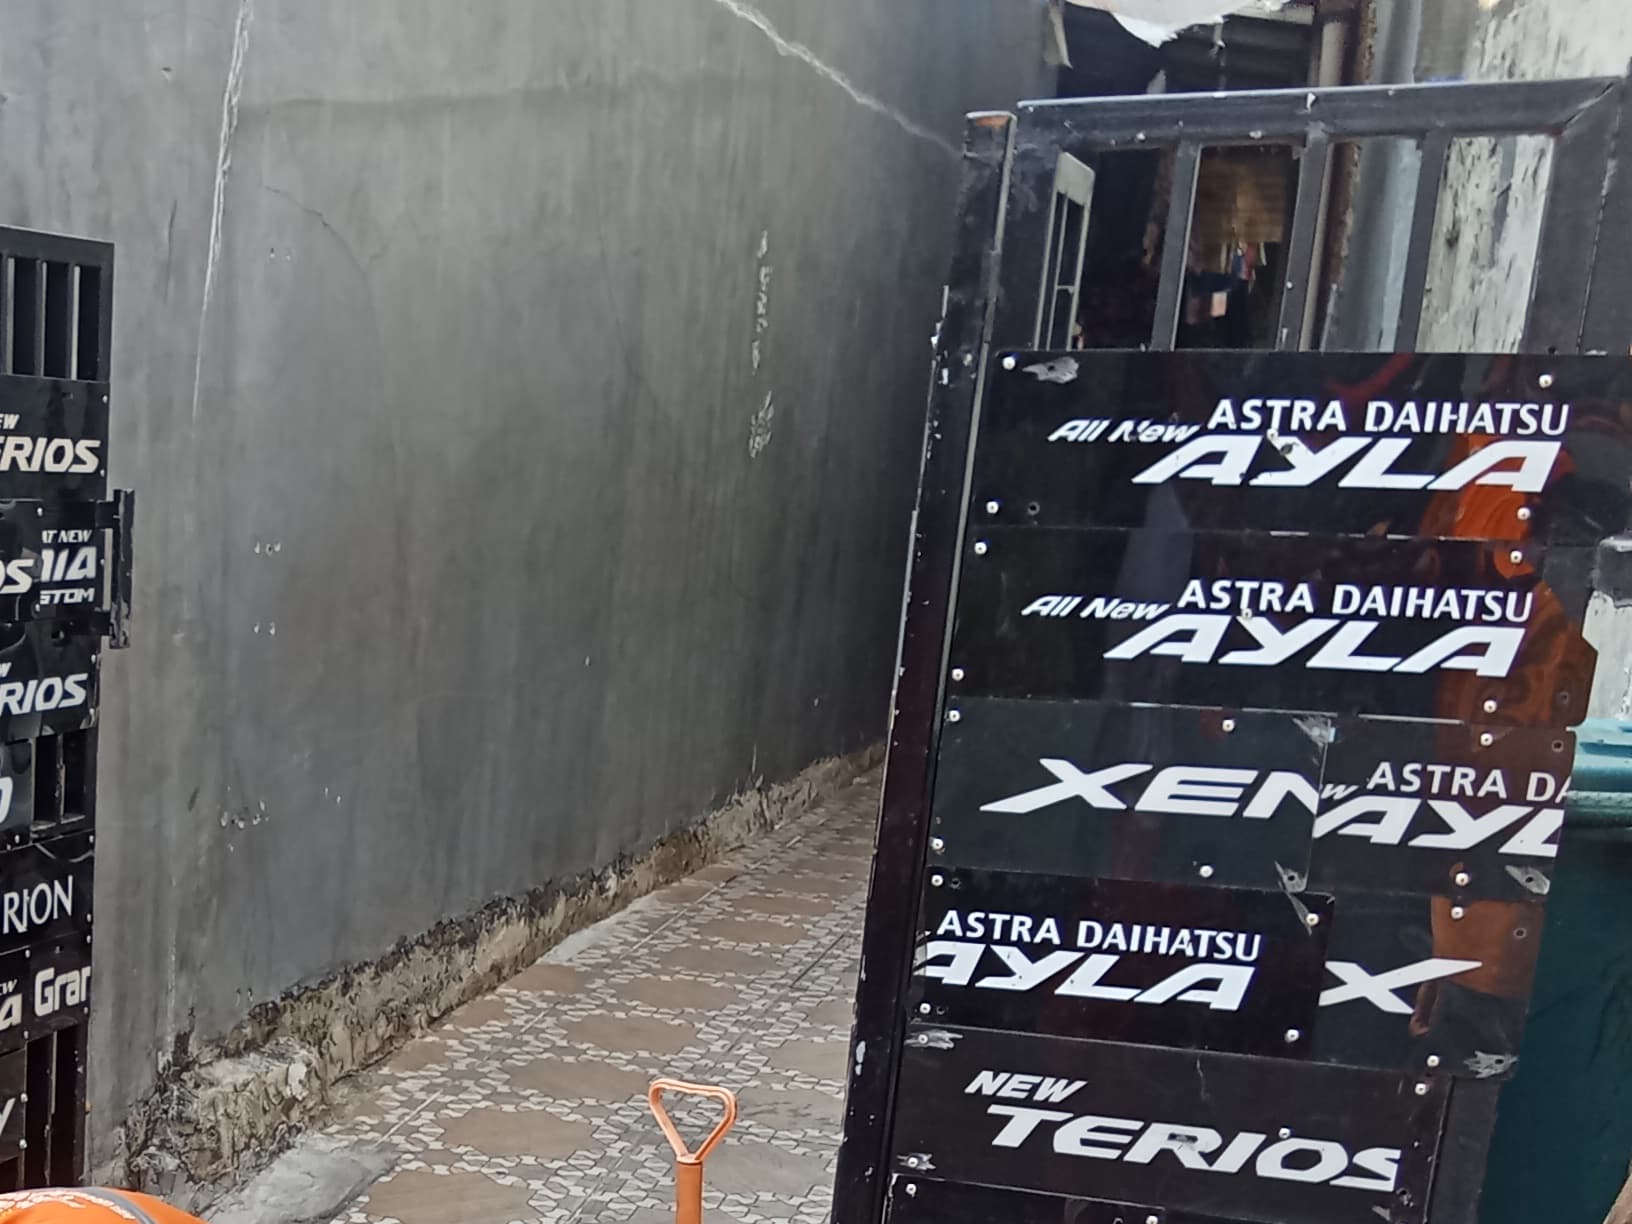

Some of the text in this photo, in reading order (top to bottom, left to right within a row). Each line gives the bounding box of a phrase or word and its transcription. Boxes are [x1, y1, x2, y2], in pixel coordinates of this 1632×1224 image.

[1048, 419, 1201, 442] All New
[1207, 398, 1569, 436] ASTRA DAIHATSU
[1131, 434, 1562, 493] AYLA
[58, 529, 92, 543] NEW
[1021, 595, 1171, 620] All New
[1177, 579, 1533, 622] ASTRA DAIHATSU
[1103, 613, 1527, 678] AYLA
[1366, 761, 1507, 799] ASTRA
[1312, 795, 1565, 858] AYL
[936, 909, 1262, 962] ASTRA DAIHATSU
[914, 940, 1256, 1012] AYLA
[964, 1070, 1088, 1103] NEW
[986, 1104, 1402, 1193] TERIOS
